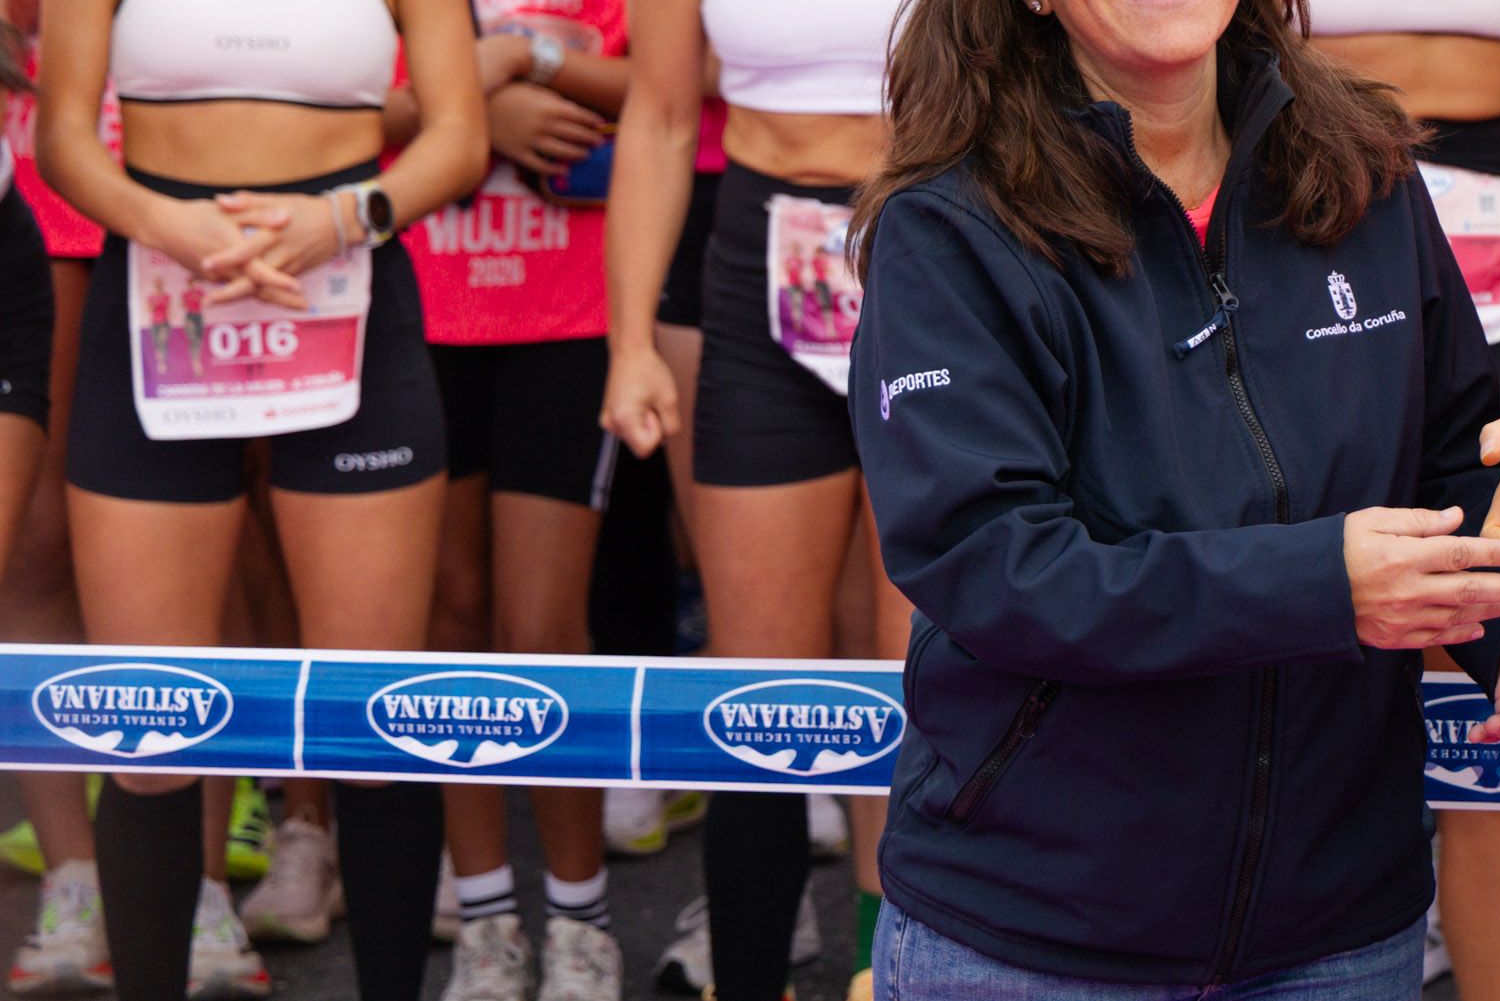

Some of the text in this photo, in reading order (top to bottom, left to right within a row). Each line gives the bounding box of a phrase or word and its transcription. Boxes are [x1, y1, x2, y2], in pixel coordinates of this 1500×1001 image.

[214, 34, 292, 52] OYSHO
[1306, 309, 1406, 339] Concello da Coruña
[209, 320, 299, 360] 016
[888, 368, 951, 400] DEPORTES
[334, 446, 414, 473] OYSHO
[50, 684, 219, 726] ASTURIANA
[382, 694, 555, 735] ASTURIANA
[53, 712, 187, 727] CENTRAL LECHERA
[388, 722, 522, 736] CENTRAL LECHERA
[720, 703, 893, 743] ASTURIANA
[725, 731, 862, 744] CENTRAL LECHERA
[1431, 749, 1478, 759] LECHE
